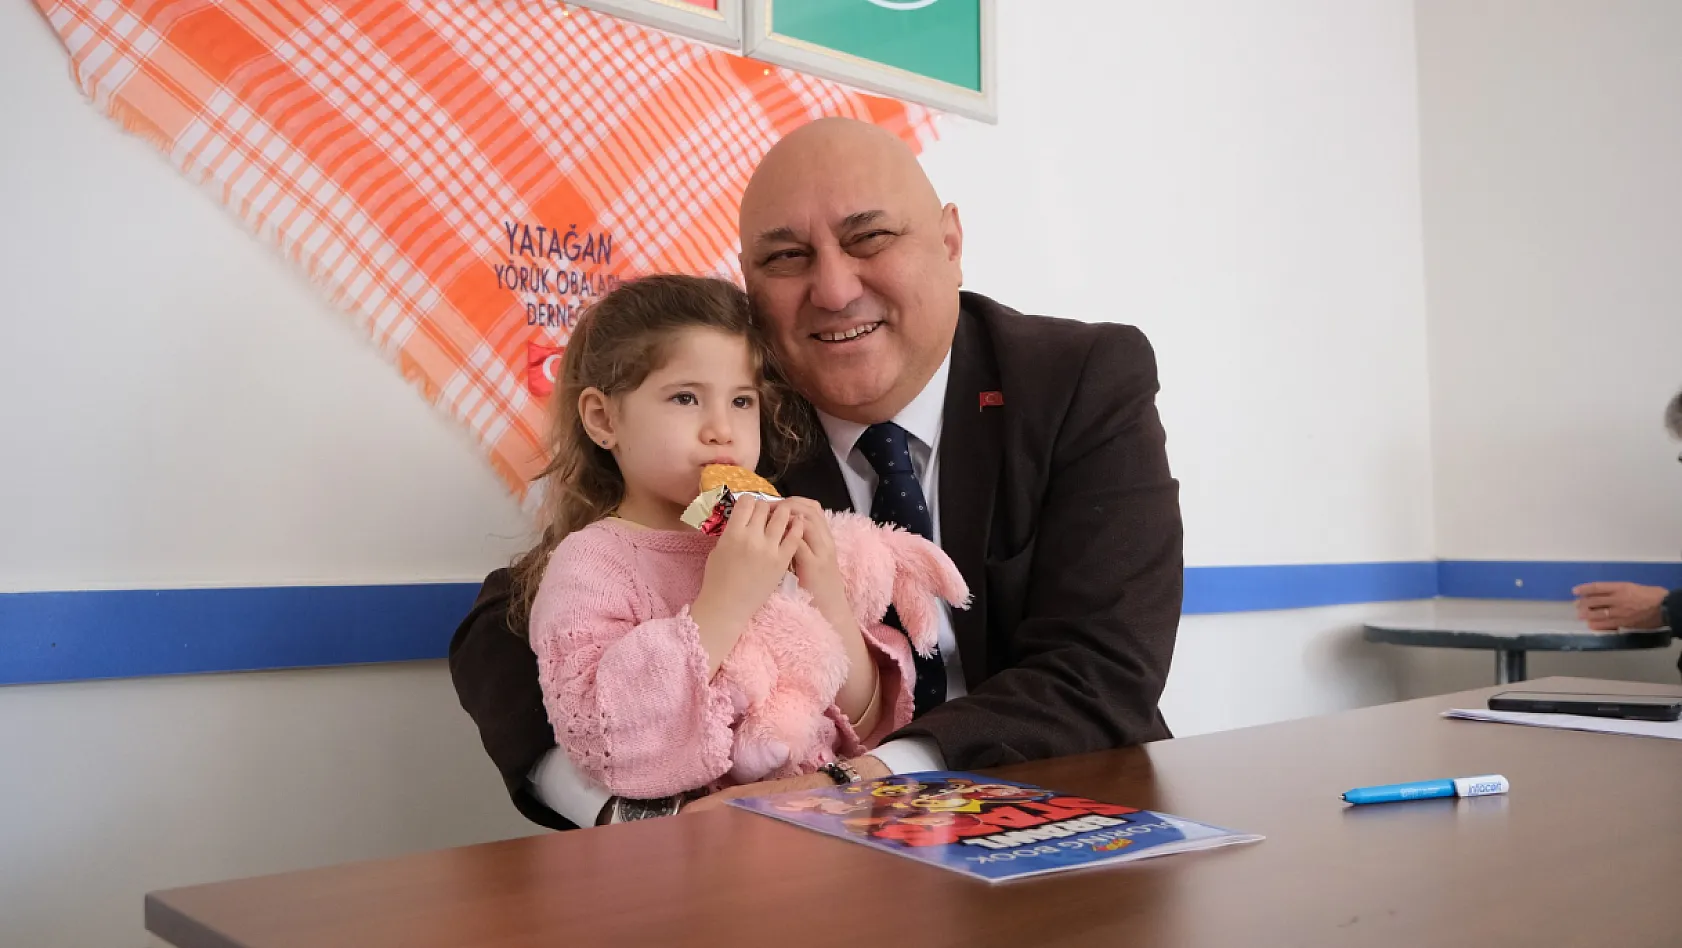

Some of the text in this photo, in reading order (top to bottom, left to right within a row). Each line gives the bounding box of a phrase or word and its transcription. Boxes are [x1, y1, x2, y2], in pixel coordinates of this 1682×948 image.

[505, 221, 613, 265] YATAĞAN
[494, 260, 550, 293] YÖRÜK
[962, 815, 1128, 849] BRAWL
[966, 845, 1060, 864] BOOK
